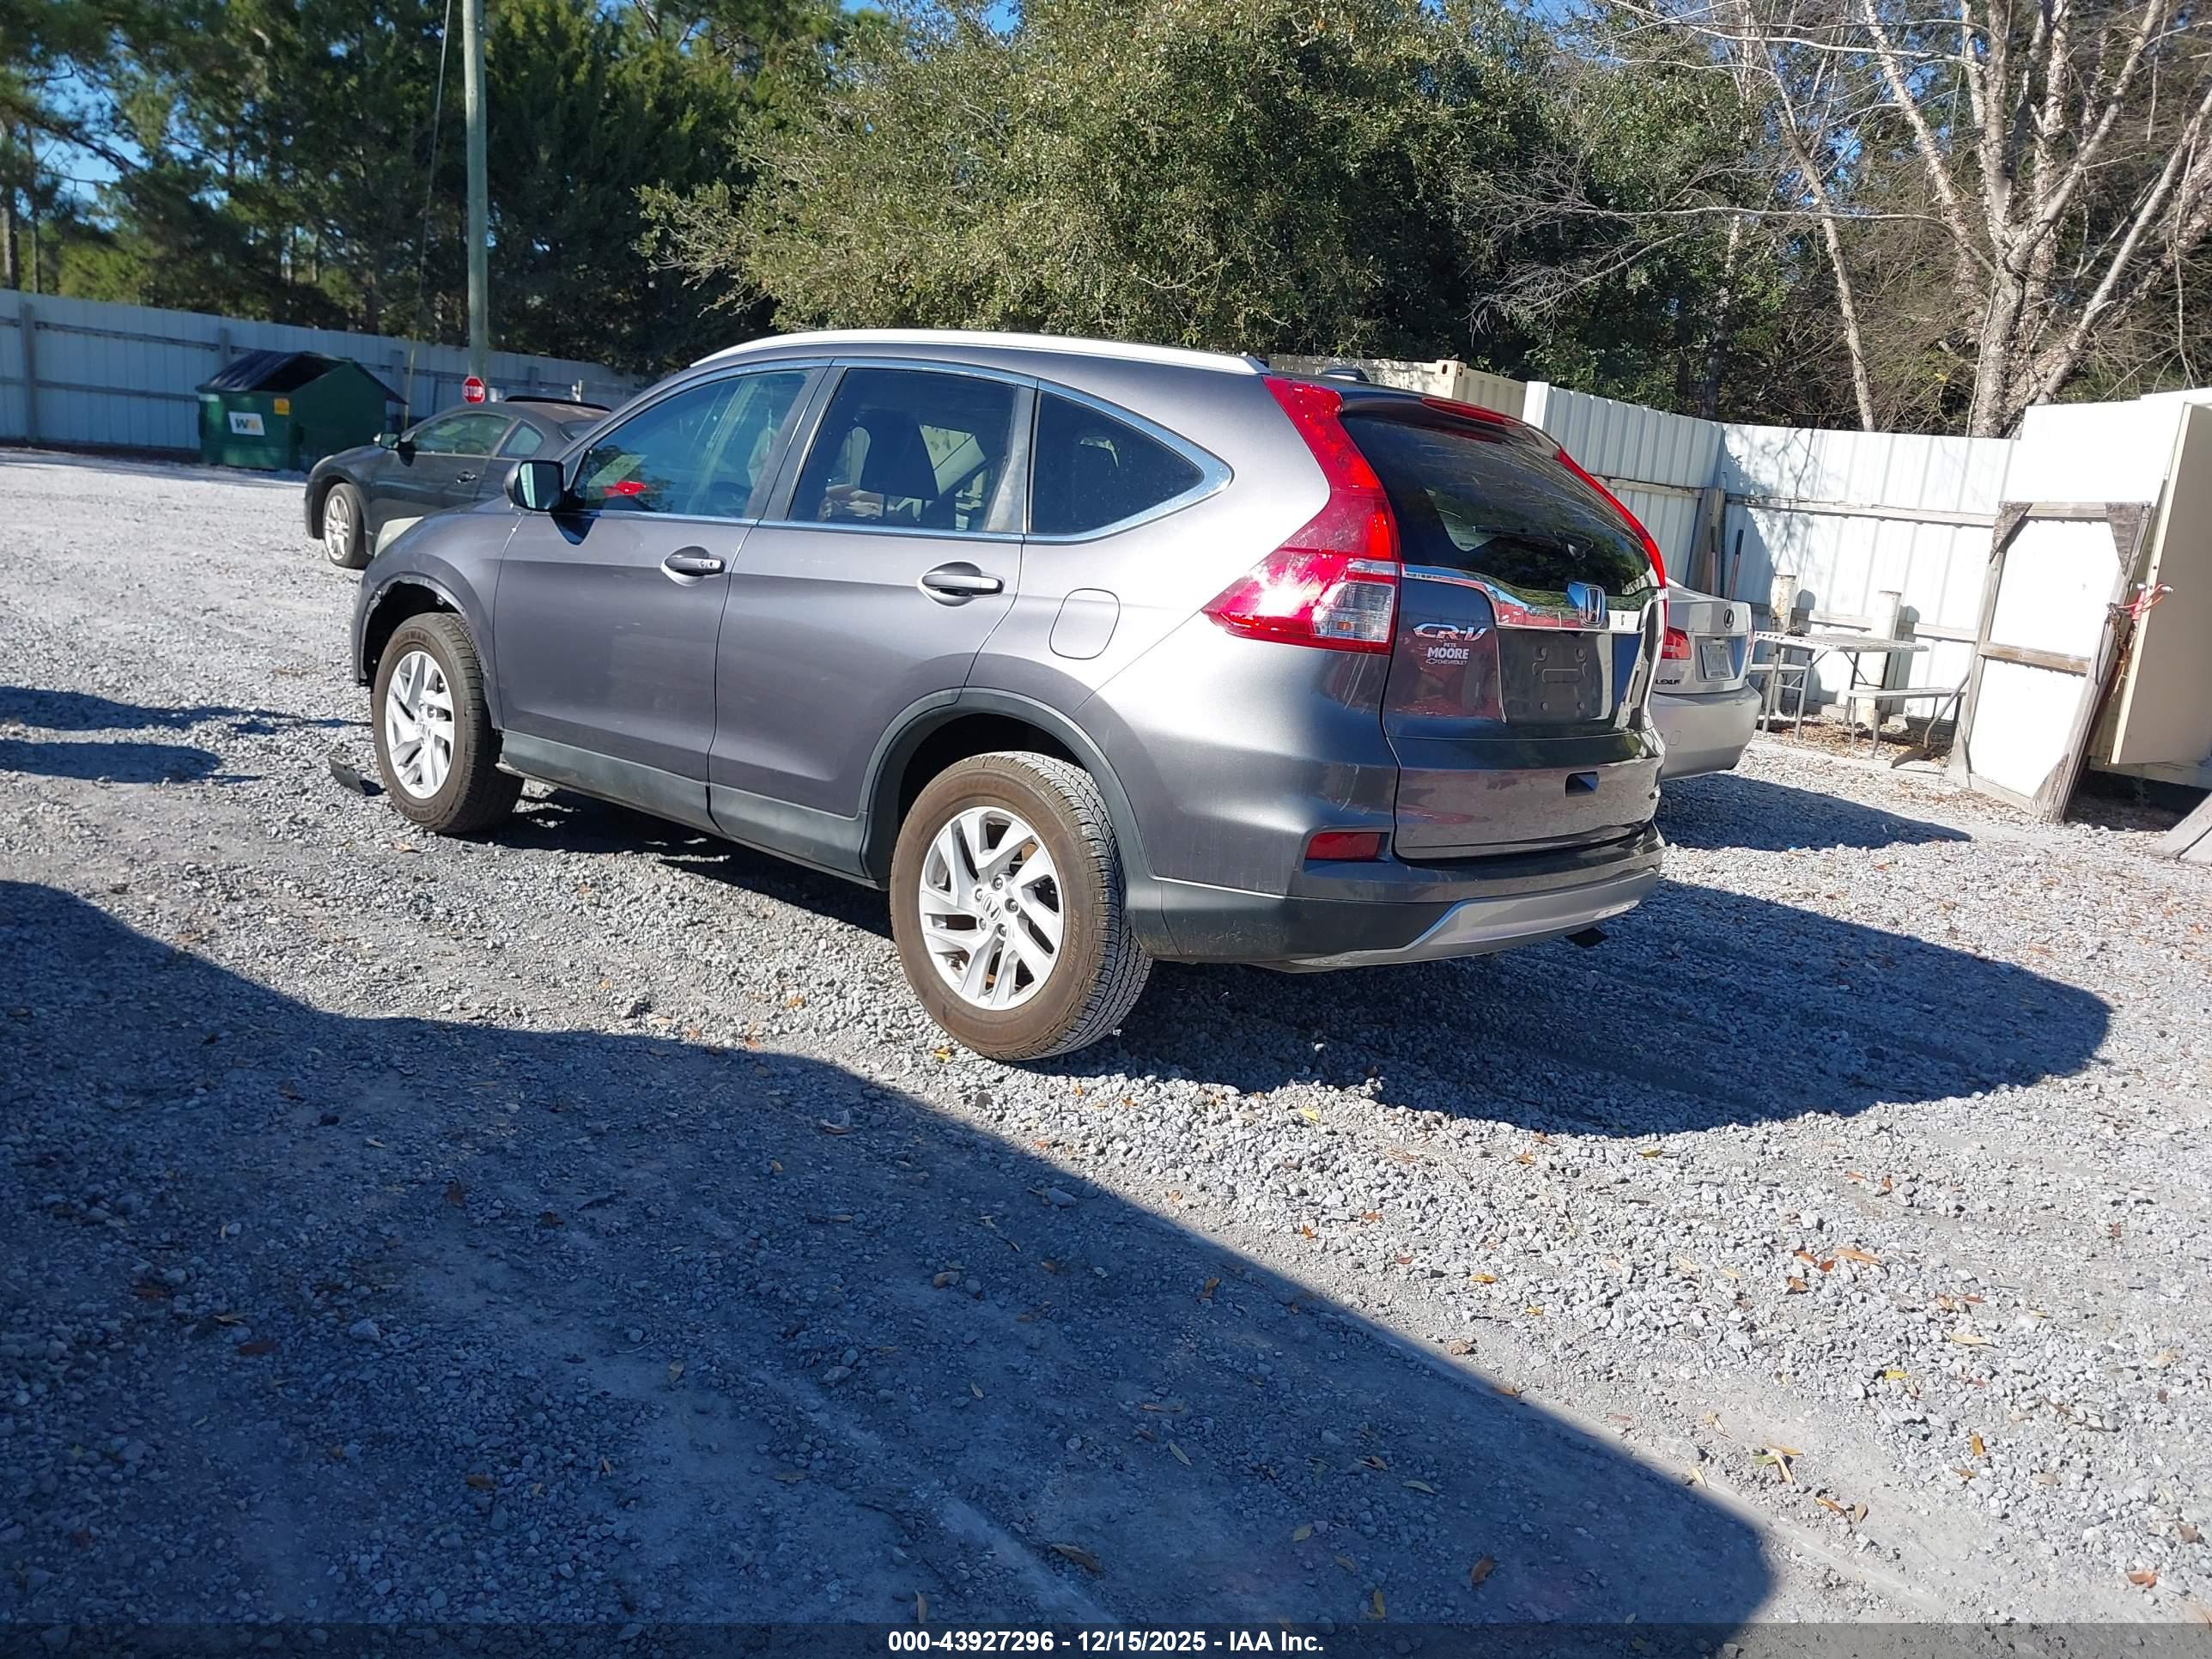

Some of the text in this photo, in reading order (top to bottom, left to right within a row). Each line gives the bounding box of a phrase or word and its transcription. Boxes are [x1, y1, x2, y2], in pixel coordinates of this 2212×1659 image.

[464, 386, 483, 398] STOP
[1413, 623, 1487, 641] CR-V
[1427, 647, 1469, 659] MOORE
